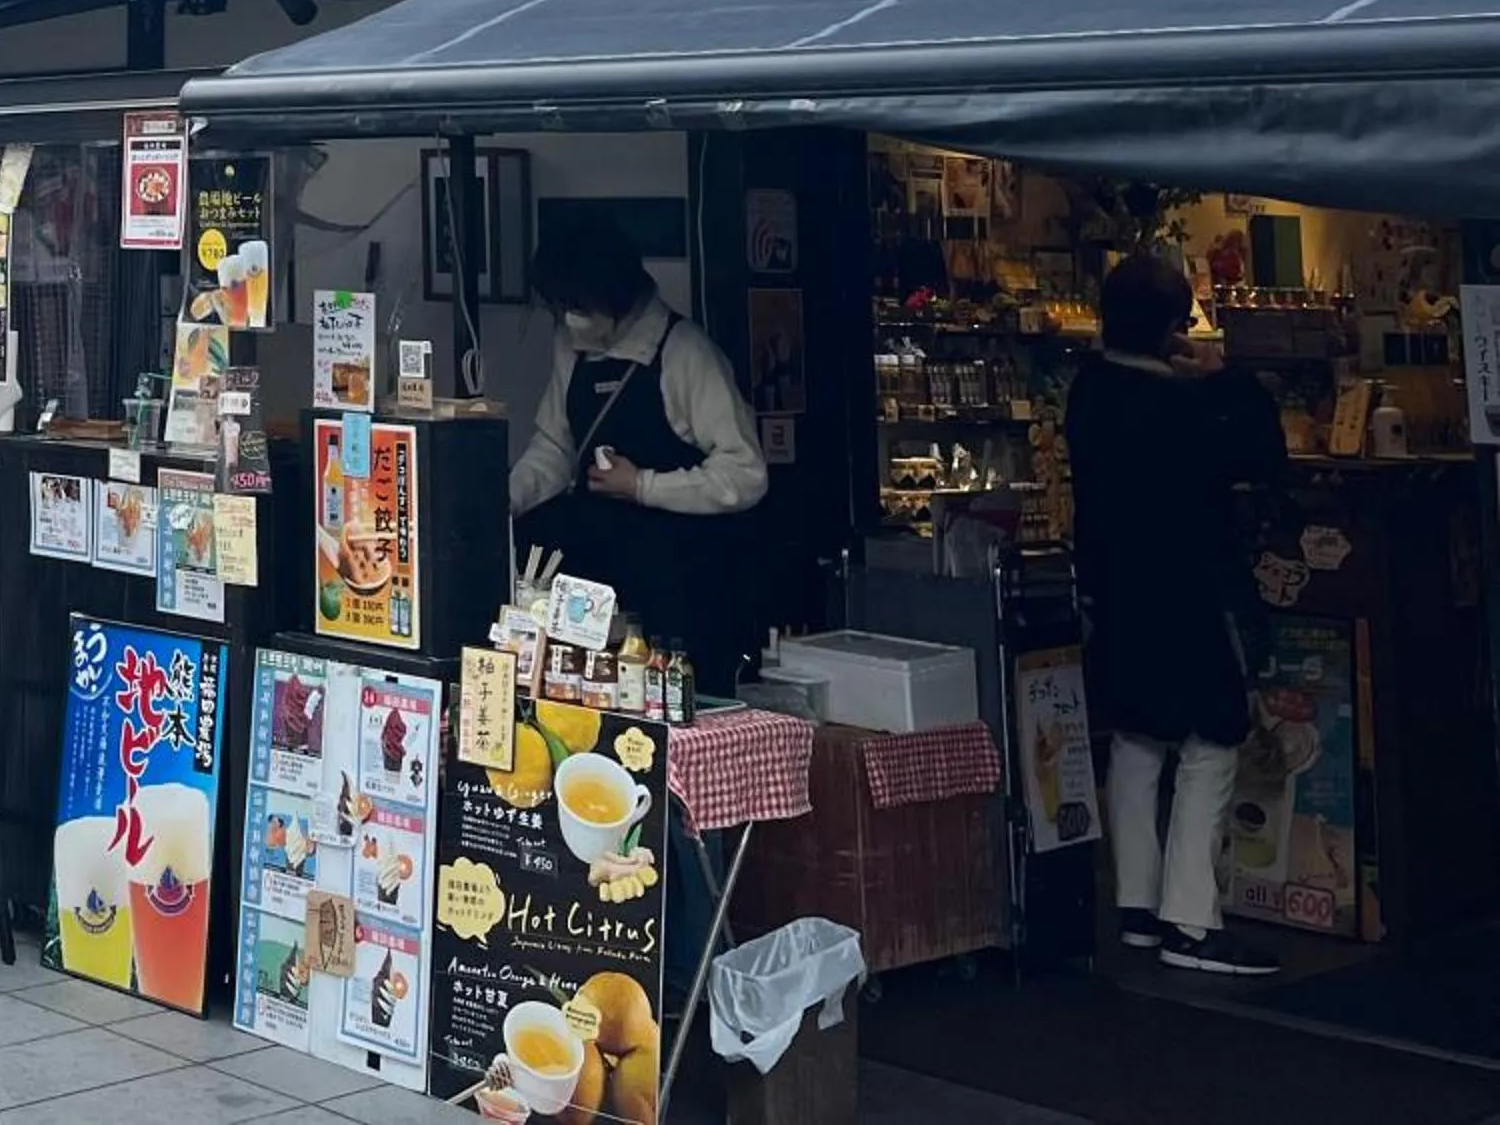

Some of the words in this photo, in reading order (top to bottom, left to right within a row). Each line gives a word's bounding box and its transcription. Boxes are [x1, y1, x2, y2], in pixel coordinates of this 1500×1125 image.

[373, 447, 394, 563] だご餃子
[161, 649, 197, 751] 熊本
[107, 644, 167, 867] 地ビール
[508, 893, 556, 933] Hot
[567, 902, 656, 953] Citrus
[453, 980, 509, 1010] ホット甘夏
